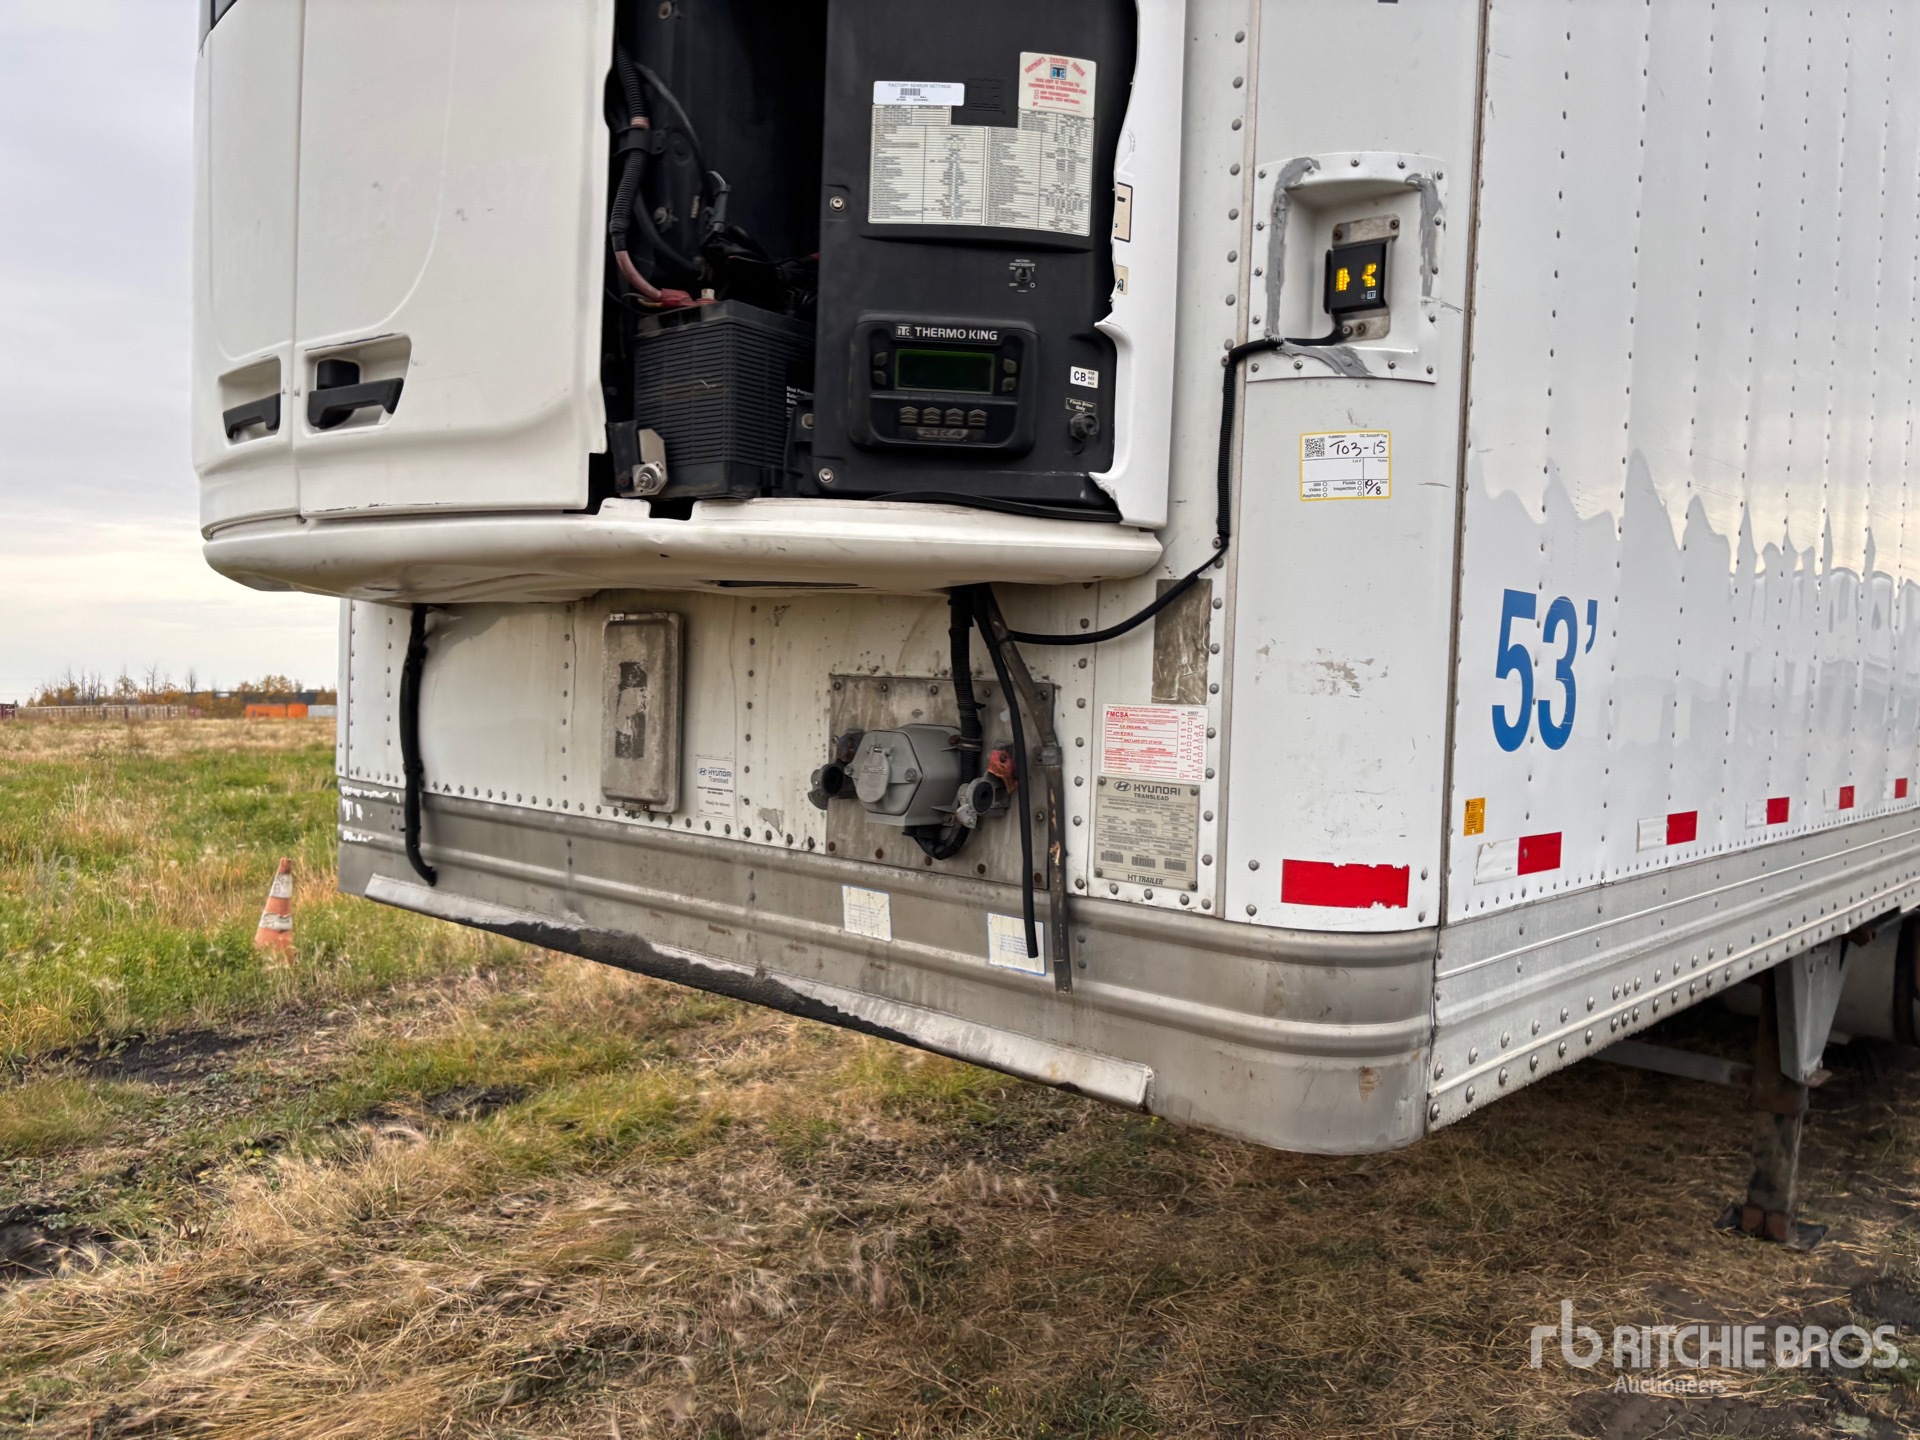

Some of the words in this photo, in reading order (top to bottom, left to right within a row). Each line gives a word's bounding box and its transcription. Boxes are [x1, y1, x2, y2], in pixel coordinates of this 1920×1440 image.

[914, 326, 967, 340] THERMO
[968, 329, 998, 341] KING
[1073, 370, 1087, 382] CB
[1328, 439, 1387, 457] T03-15
[1106, 710, 1129, 718] FMCSA
[708, 769, 733, 778] HYUNDAI
[1133, 783, 1181, 796] HYUNDAI
[1133, 792, 1170, 802] TRANSLEAD
[1127, 873, 1138, 882] HT
[1138, 875, 1165, 886] TRAILER
